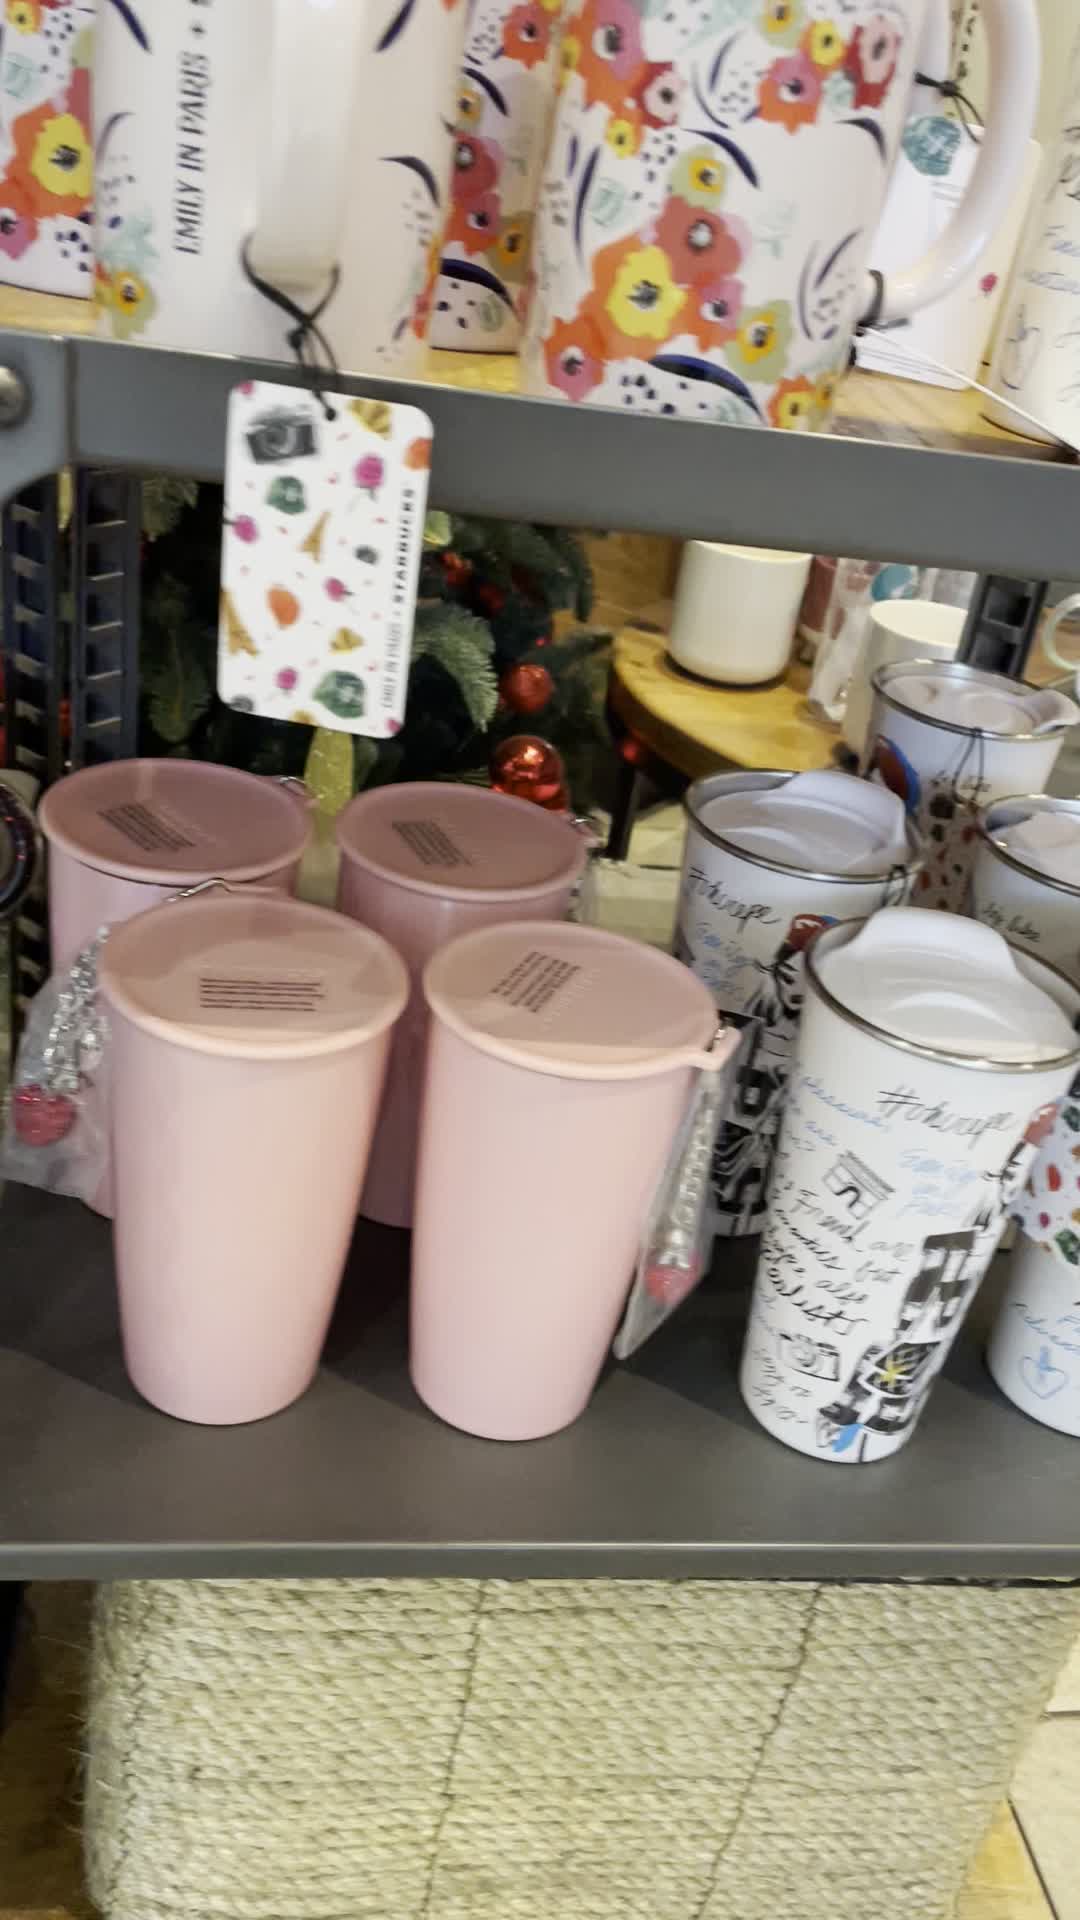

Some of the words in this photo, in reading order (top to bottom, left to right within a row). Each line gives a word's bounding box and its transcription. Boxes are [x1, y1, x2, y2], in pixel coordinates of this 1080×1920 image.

[178, 51, 211, 136] PARIS
[177, 143, 205, 173] IN
[174, 180, 202, 255] EMILY
[391, 488, 414, 605] STARBUCKS
